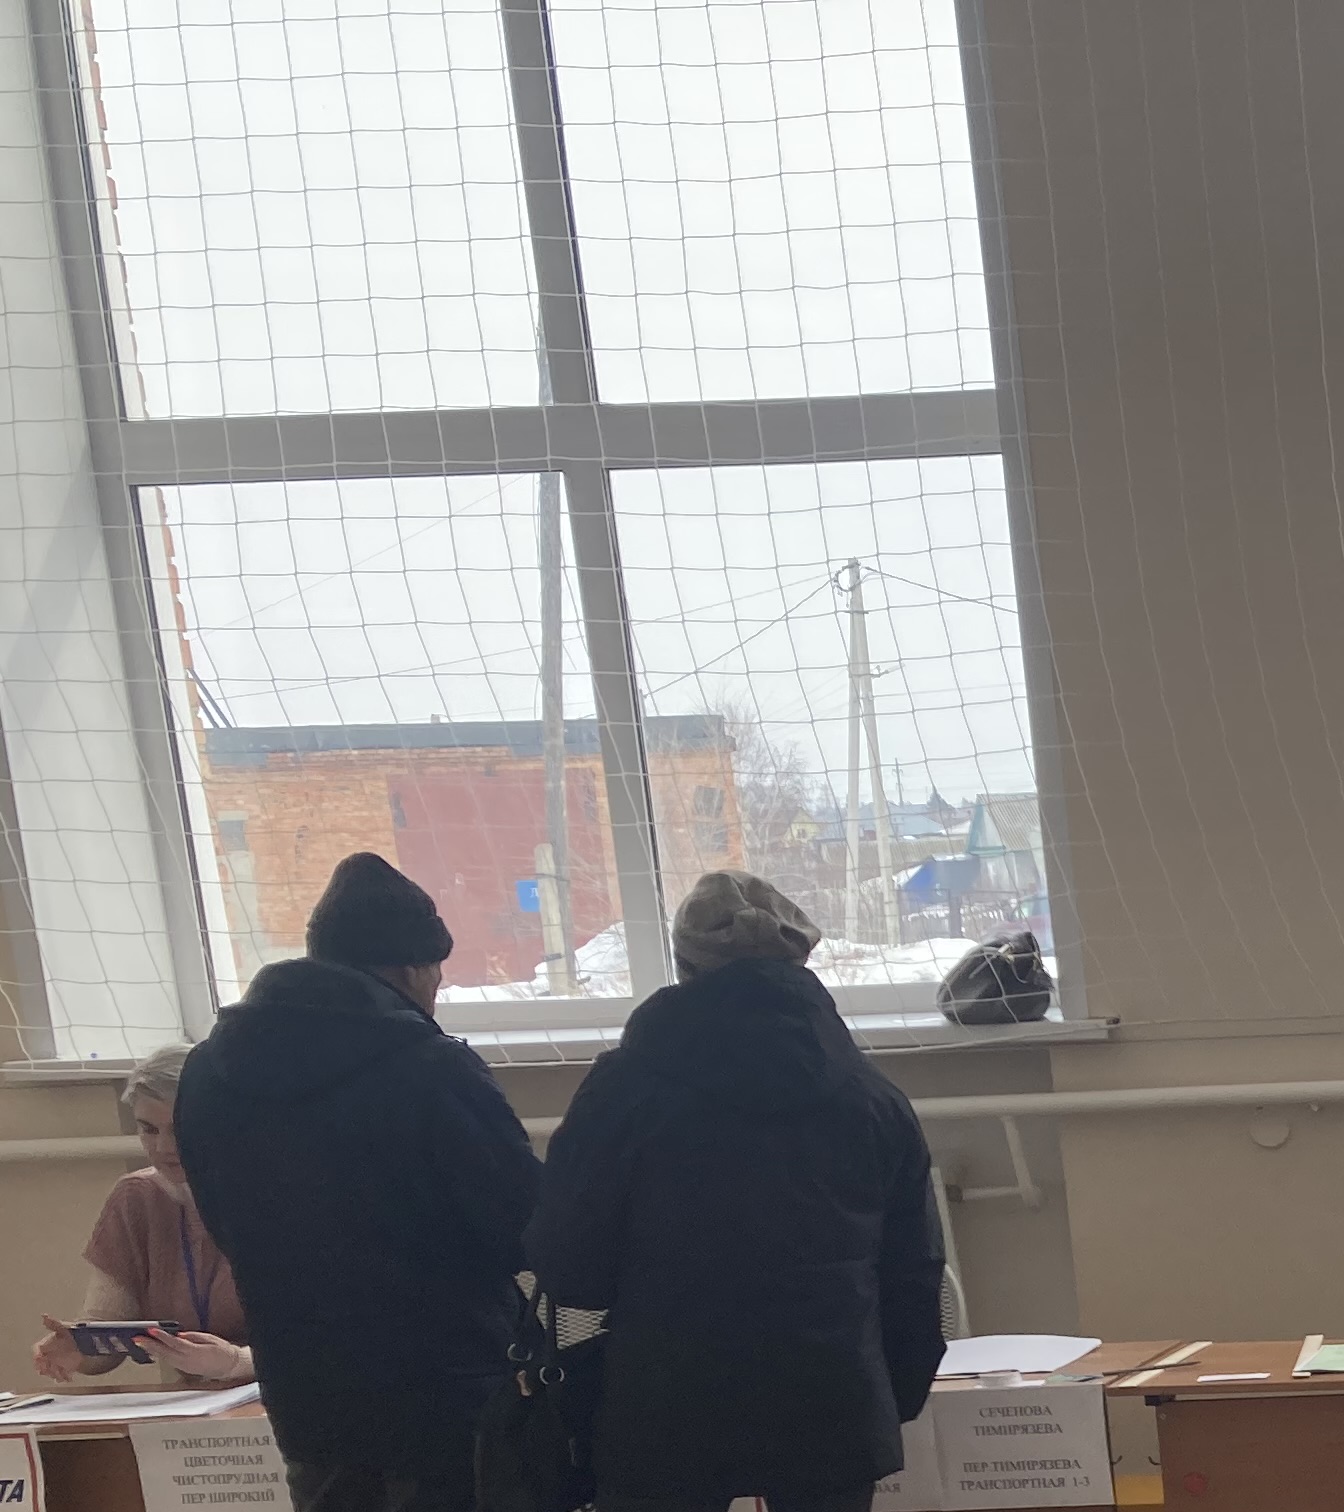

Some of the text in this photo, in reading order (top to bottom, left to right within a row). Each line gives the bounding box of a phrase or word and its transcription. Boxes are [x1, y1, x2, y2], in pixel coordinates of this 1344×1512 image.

[972, 1423, 1063, 1436] ТИМИРЯЗЕВА
[161, 1435, 271, 1450] ТРАНСПОРТНАЯ
[184, 1454, 264, 1468] ЦВЕТОЧНАЯ
[172, 1472, 280, 1486] ЧИСТОПРУДНАЯ
[960, 1477, 1065, 1491] ТРАНСПОРТНАЯ
